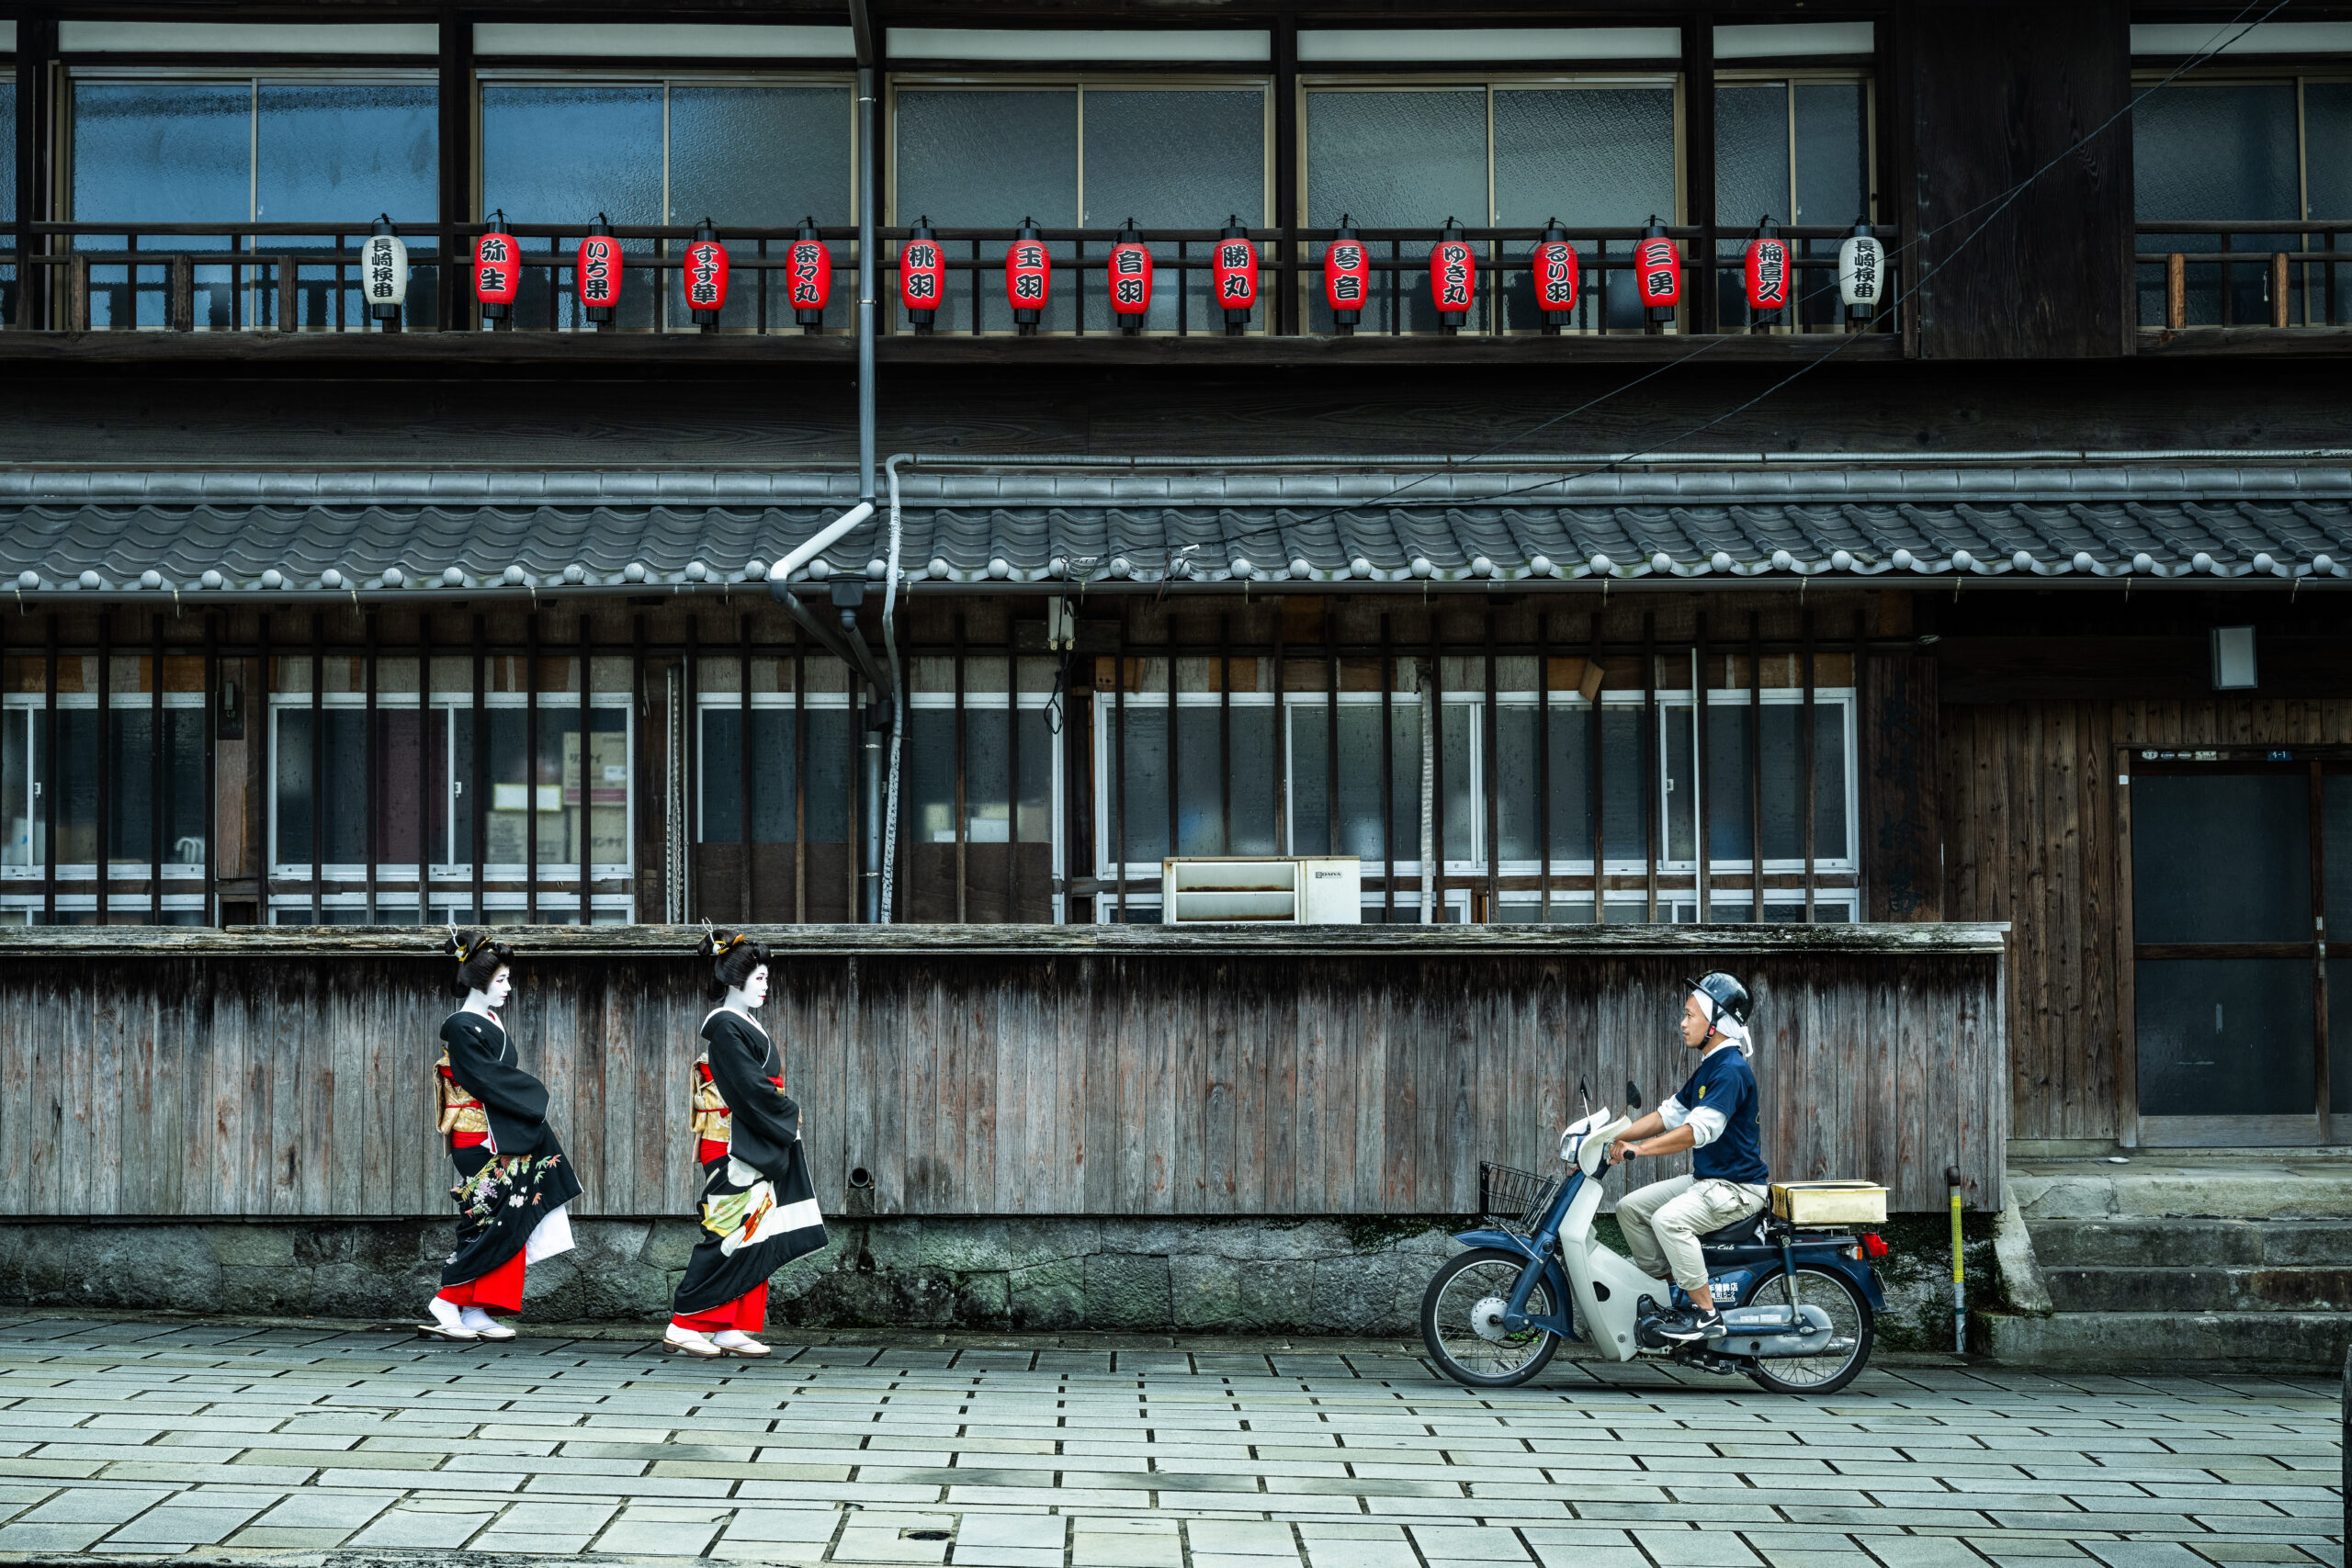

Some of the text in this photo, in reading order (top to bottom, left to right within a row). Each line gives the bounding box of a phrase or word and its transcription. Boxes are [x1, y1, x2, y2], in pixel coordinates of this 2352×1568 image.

[371, 238, 394, 298] 長崎検番
[480, 239, 508, 292] 弥生
[584, 242, 610, 300] いち果
[693, 245, 719, 304] すず華
[795, 244, 820, 303] 茶々丸
[909, 245, 935, 298] 桃羽
[1016, 246, 1044, 299] 玉羽
[1116, 250, 1144, 303] 音羽
[1222, 244, 1250, 298] 勝丸
[1334, 245, 1361, 300] 琴音
[1443, 245, 1468, 304] ゆき丸
[1546, 244, 1571, 303] るり羽
[1645, 243, 1674, 296] 三勇
[1758, 243, 1784, 301] 梅喜久
[1854, 240, 1875, 298] 長崎検番
